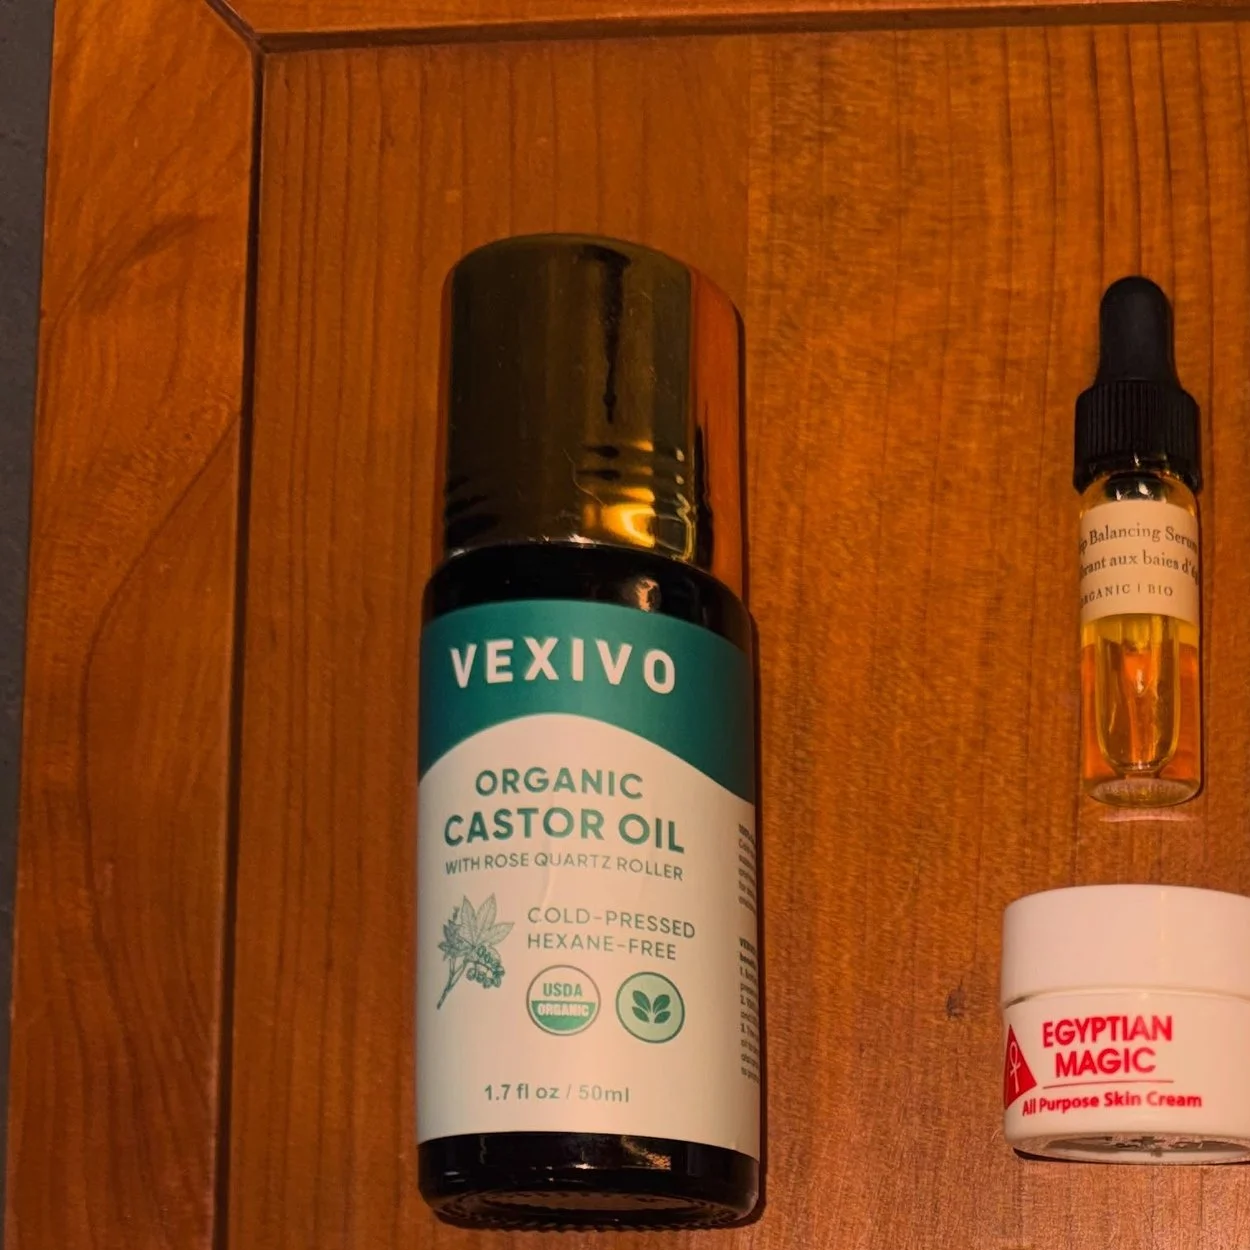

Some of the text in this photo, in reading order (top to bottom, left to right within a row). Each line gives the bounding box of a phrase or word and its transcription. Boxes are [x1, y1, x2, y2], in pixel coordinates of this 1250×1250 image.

[1089, 522, 1161, 546] Balancing
[1109, 554, 1139, 567] aux
[1143, 549, 1179, 570] baies
[1148, 583, 1174, 597] BIO
[451, 636, 677, 695] VEXIVO
[475, 766, 644, 800] ORGANIC
[444, 807, 686, 855] CASTOR OIL
[445, 852, 684, 881] WITH ROSE QUARTZ ROLLER
[527, 906, 697, 939] COLD-PRESSED
[527, 932, 678, 961] HEXANE-FREE
[543, 982, 583, 997] USDA
[537, 1003, 589, 1018] ORGANIC
[1042, 1014, 1173, 1048] EGYPTIAN
[1055, 1047, 1156, 1078] MAGIC
[483, 1084, 510, 1101] 1.7
[516, 1083, 530, 1100] fl
[535, 1086, 561, 1100] oz
[578, 1085, 630, 1103] 50ml
[1022, 1091, 1202, 1117] All Purpose Skin Cream
